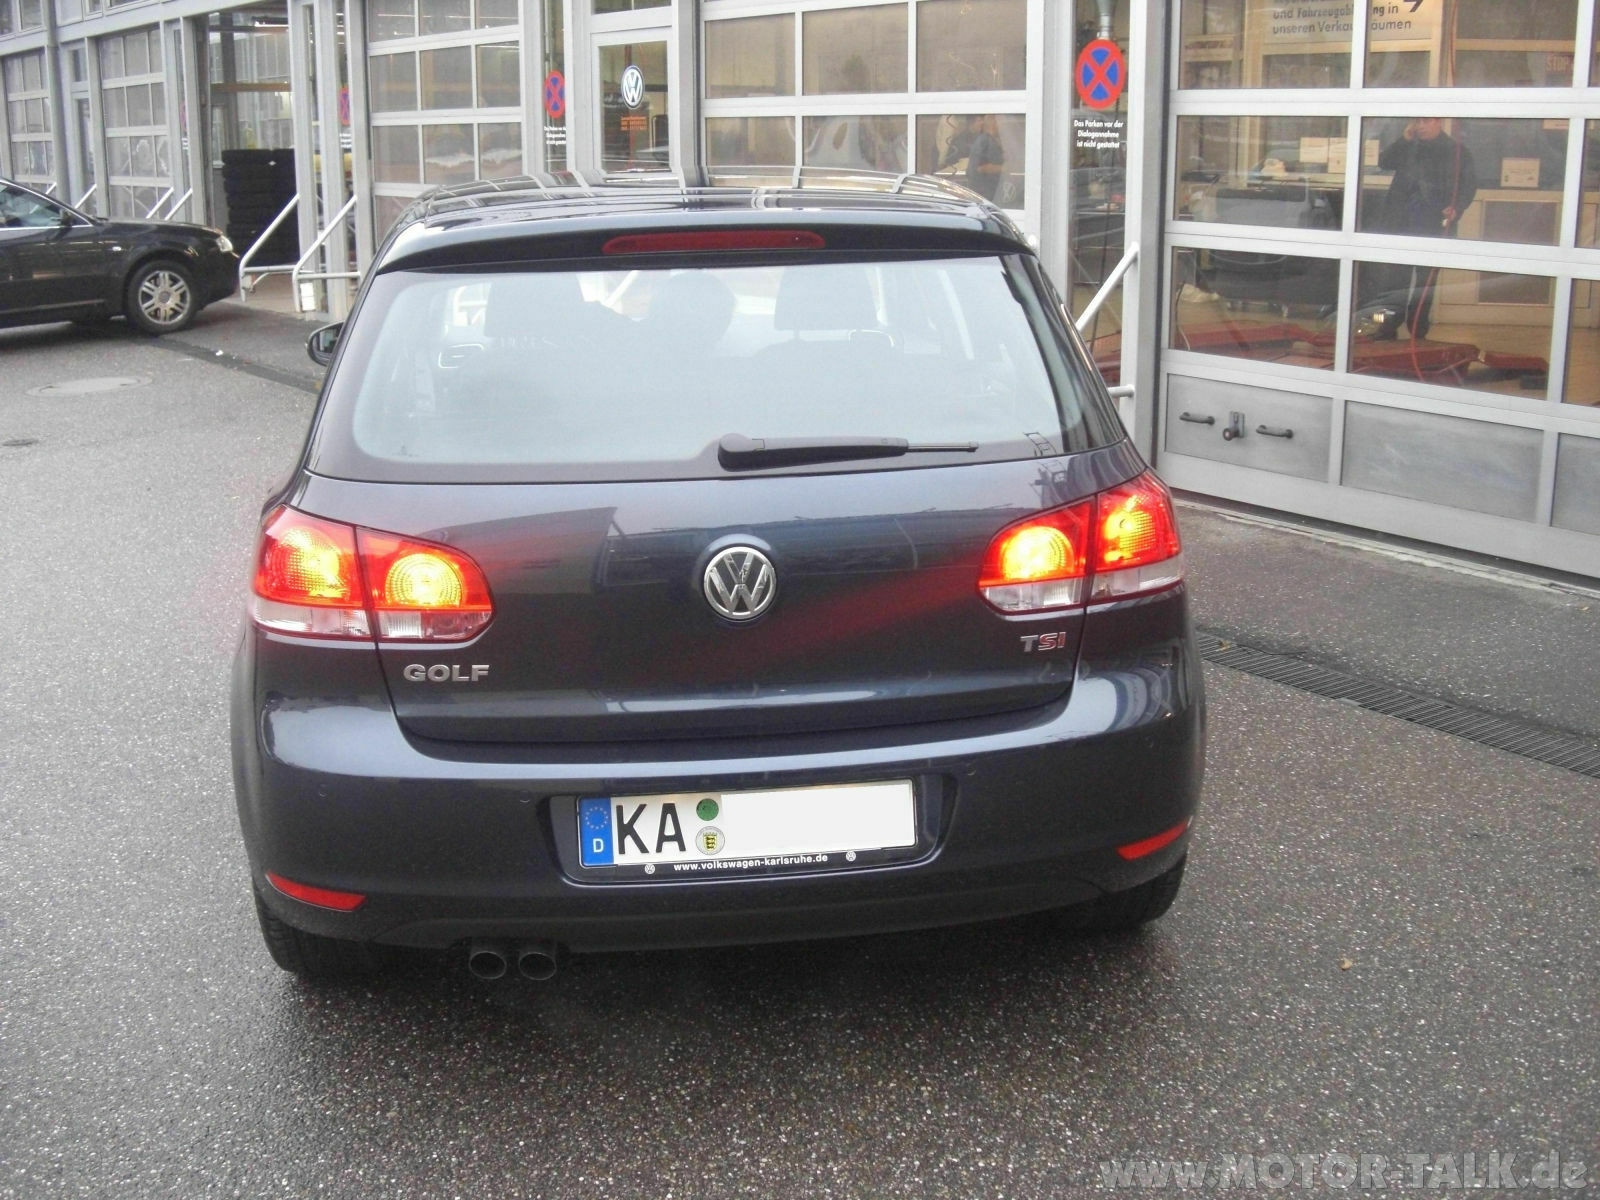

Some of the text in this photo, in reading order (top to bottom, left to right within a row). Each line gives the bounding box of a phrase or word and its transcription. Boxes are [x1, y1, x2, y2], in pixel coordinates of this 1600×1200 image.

[1272, 8, 1294, 20] und
[1387, 2, 1399, 14] in
[1272, 23, 1316, 35] unseren
[1114, 120, 1123, 128] der
[1020, 631, 1067, 653] TSI
[403, 663, 490, 682] GOLF
[592, 802, 687, 855] D KA
[673, 853, 829, 872] www.volkswagen-karlsruhe.de
